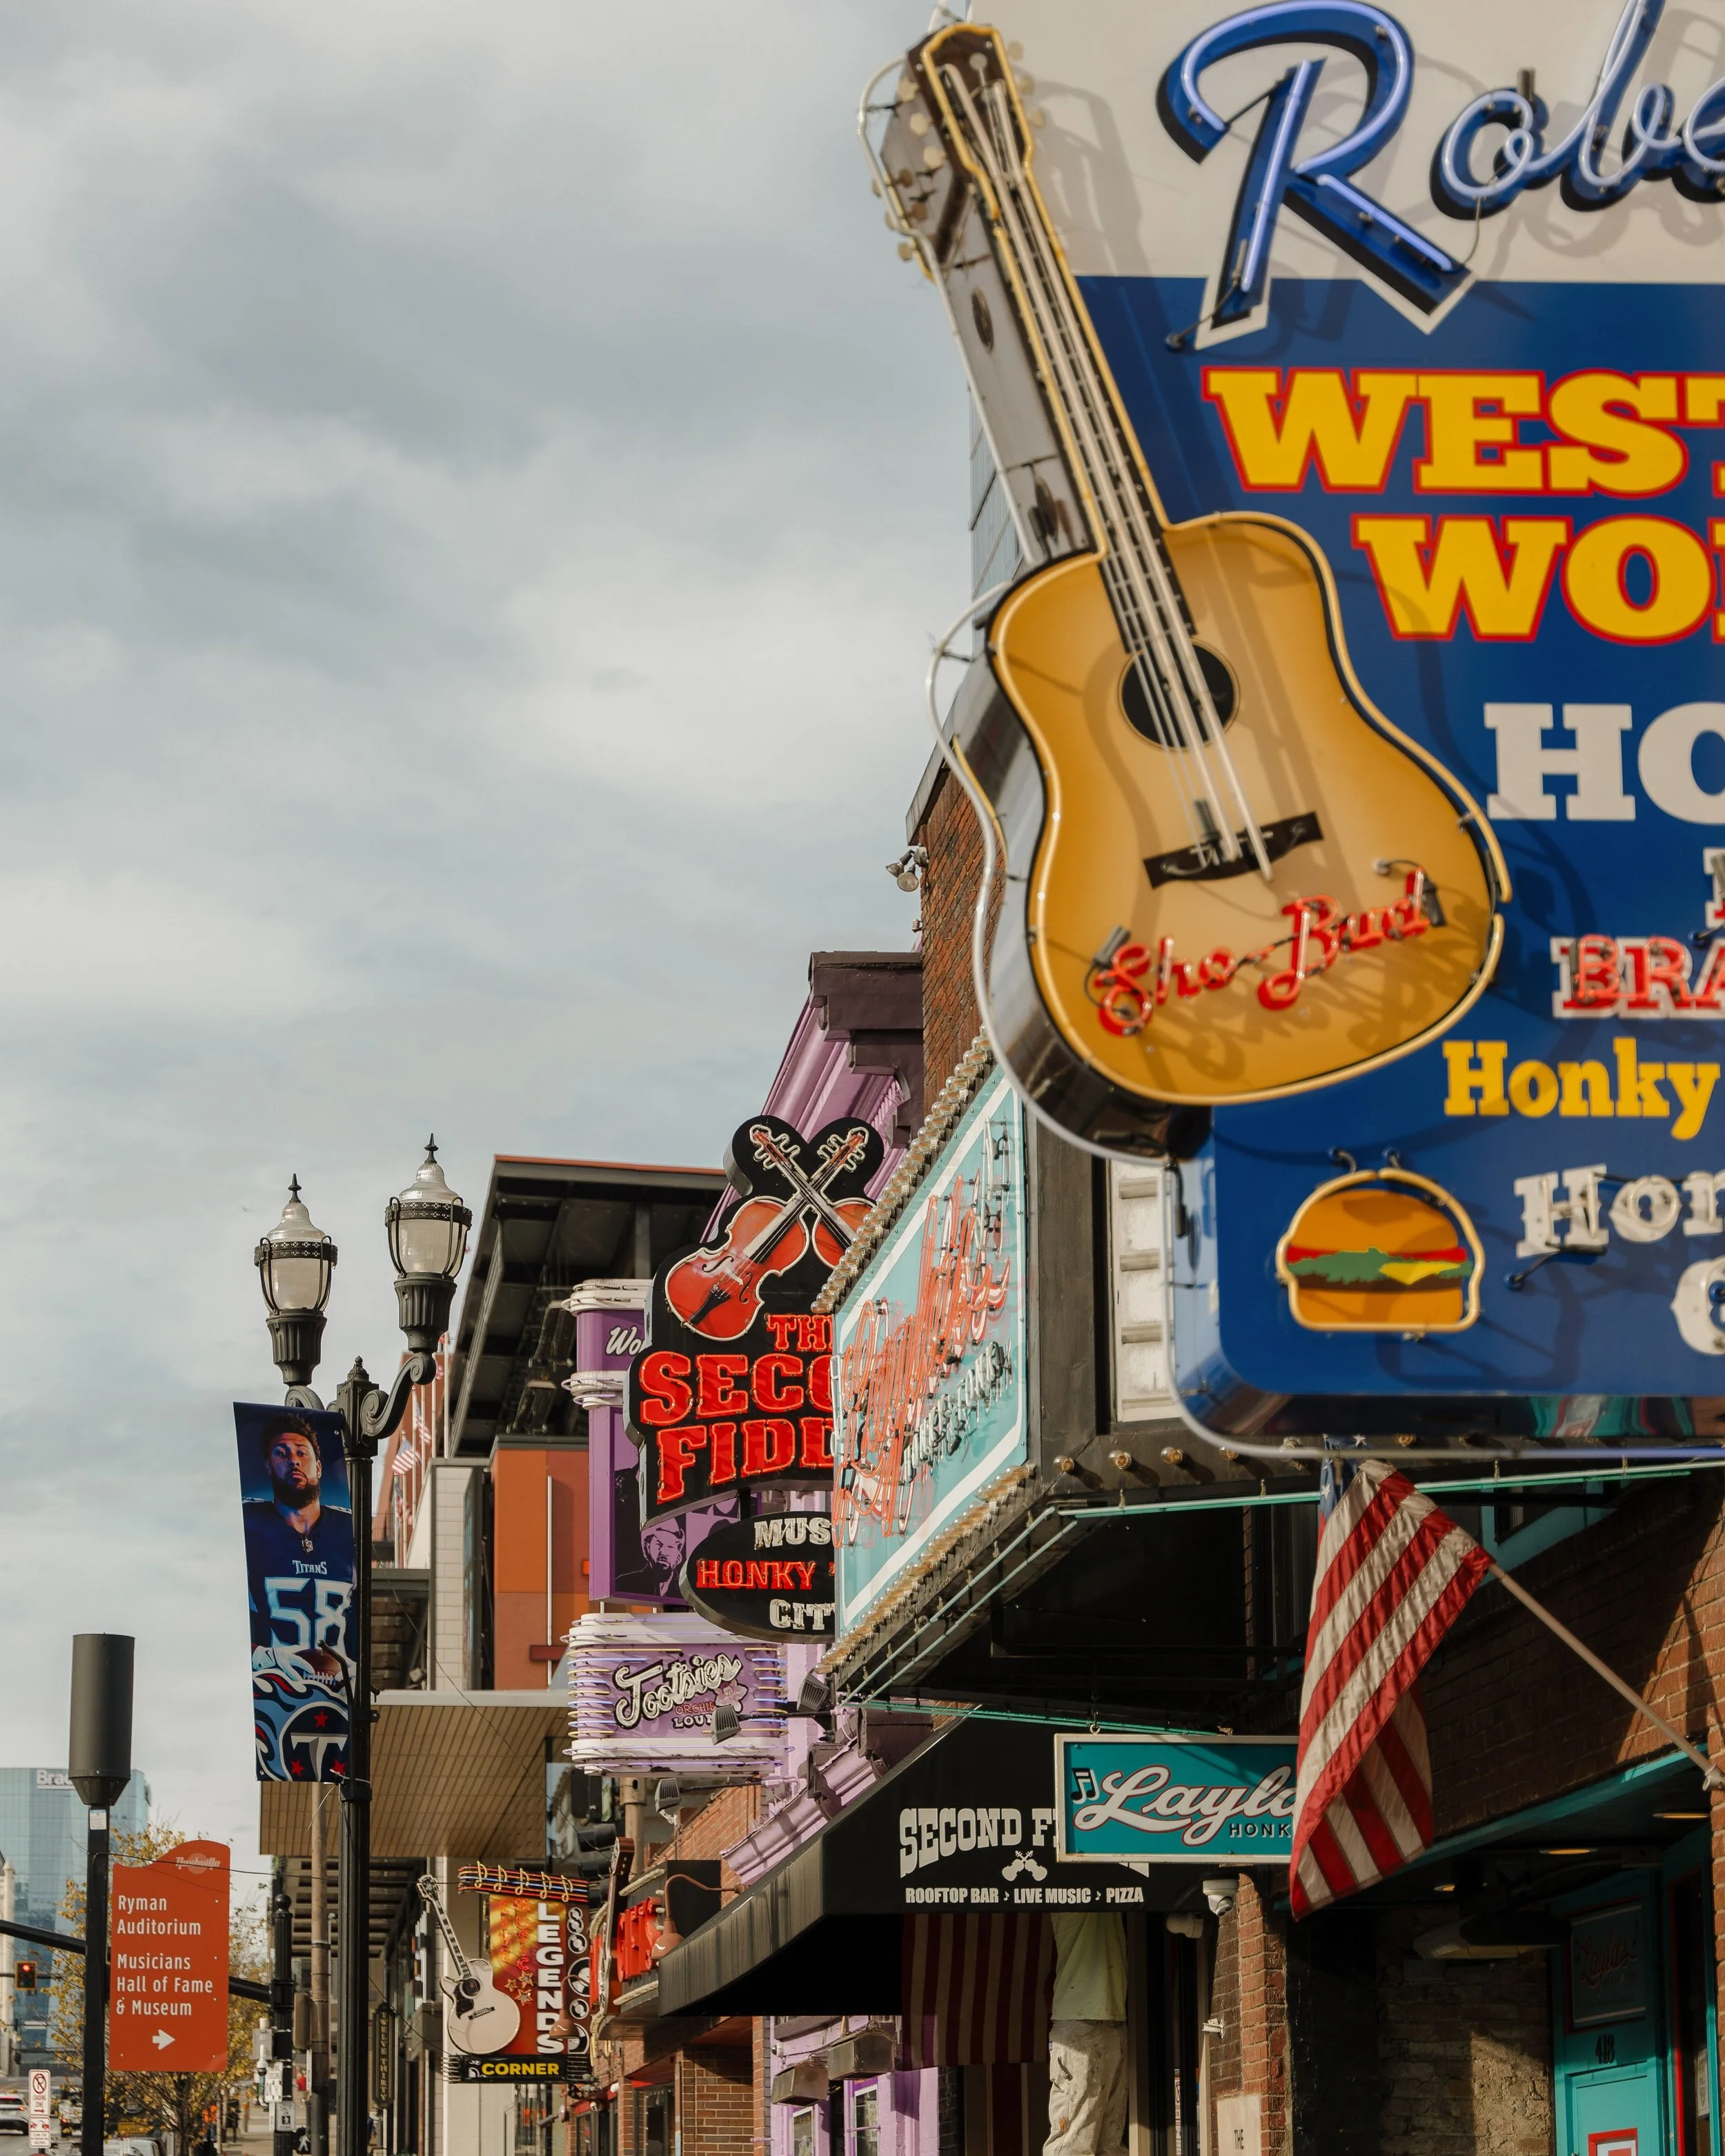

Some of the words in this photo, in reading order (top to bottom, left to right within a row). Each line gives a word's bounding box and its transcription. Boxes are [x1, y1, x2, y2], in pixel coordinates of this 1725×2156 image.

[1442, 1037, 1721, 1140] Honky
[766, 1314, 833, 1352] TH
[696, 1559, 816, 1590] HONKY
[264, 1577, 354, 1650] 58
[613, 1653, 743, 1728] Tootsies
[1229, 1823, 1291, 1838] HONK
[900, 1808, 1021, 1878] SECOND
[118, 1895, 167, 1915] Ryman
[905, 1888, 967, 1903] ROOFTOP
[970, 1888, 999, 1903] BAR
[1014, 1888, 1043, 1903] LIVE
[1045, 1888, 1091, 1903] MUSIC
[1106, 1887, 1144, 1903] PIZZA
[117, 1918, 201, 1935] Auditorium
[117, 1952, 191, 1970] Musicians
[117, 1976, 147, 1992] Hall
[152, 1976, 168, 1992] of
[174, 1977, 213, 1993] Fame
[535, 1902, 564, 2055] LEGENDS
[116, 1999, 126, 2015] &
[131, 1999, 193, 2016] Museum
[1595, 2034, 1615, 2063] 418
[482, 2063, 560, 2075] CORNER
[1234, 2129, 1244, 2150] THE
